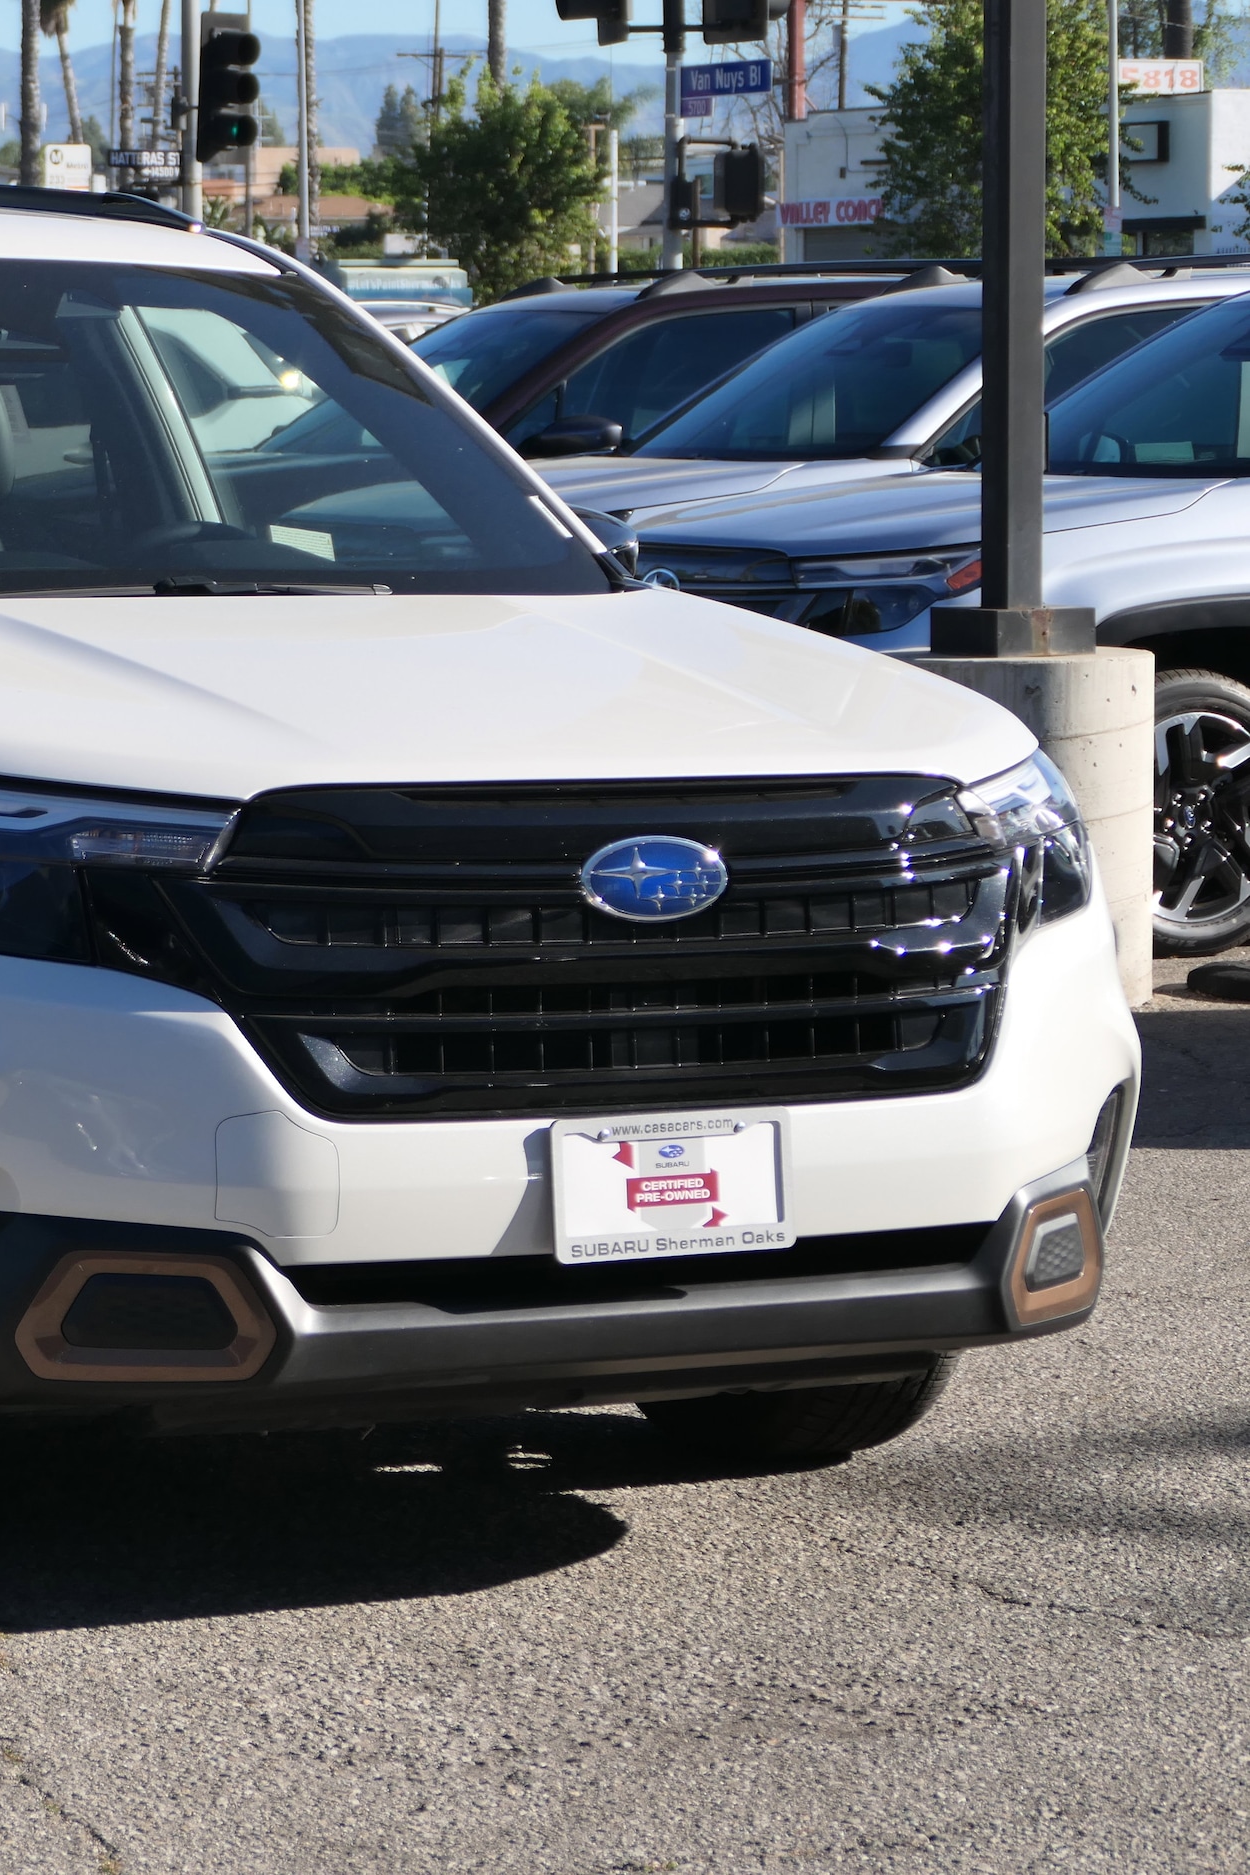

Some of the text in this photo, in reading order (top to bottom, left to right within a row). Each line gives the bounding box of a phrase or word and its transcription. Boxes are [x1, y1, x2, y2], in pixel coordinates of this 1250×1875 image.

[691, 65, 761, 93] Van Nuys Bl
[1121, 67, 1199, 89] 5818
[688, 101, 706, 115] 5700
[110, 151, 164, 166] HATTERAS
[780, 201, 830, 224] VALLEY
[612, 1118, 733, 1136] www.casacars.com
[655, 1161, 690, 1169] SUBARU
[642, 1178, 704, 1191] CERTIFIED
[636, 1189, 710, 1203] PRE-OWNED
[571, 1230, 786, 1258] SUBARU Sherman Oaks
